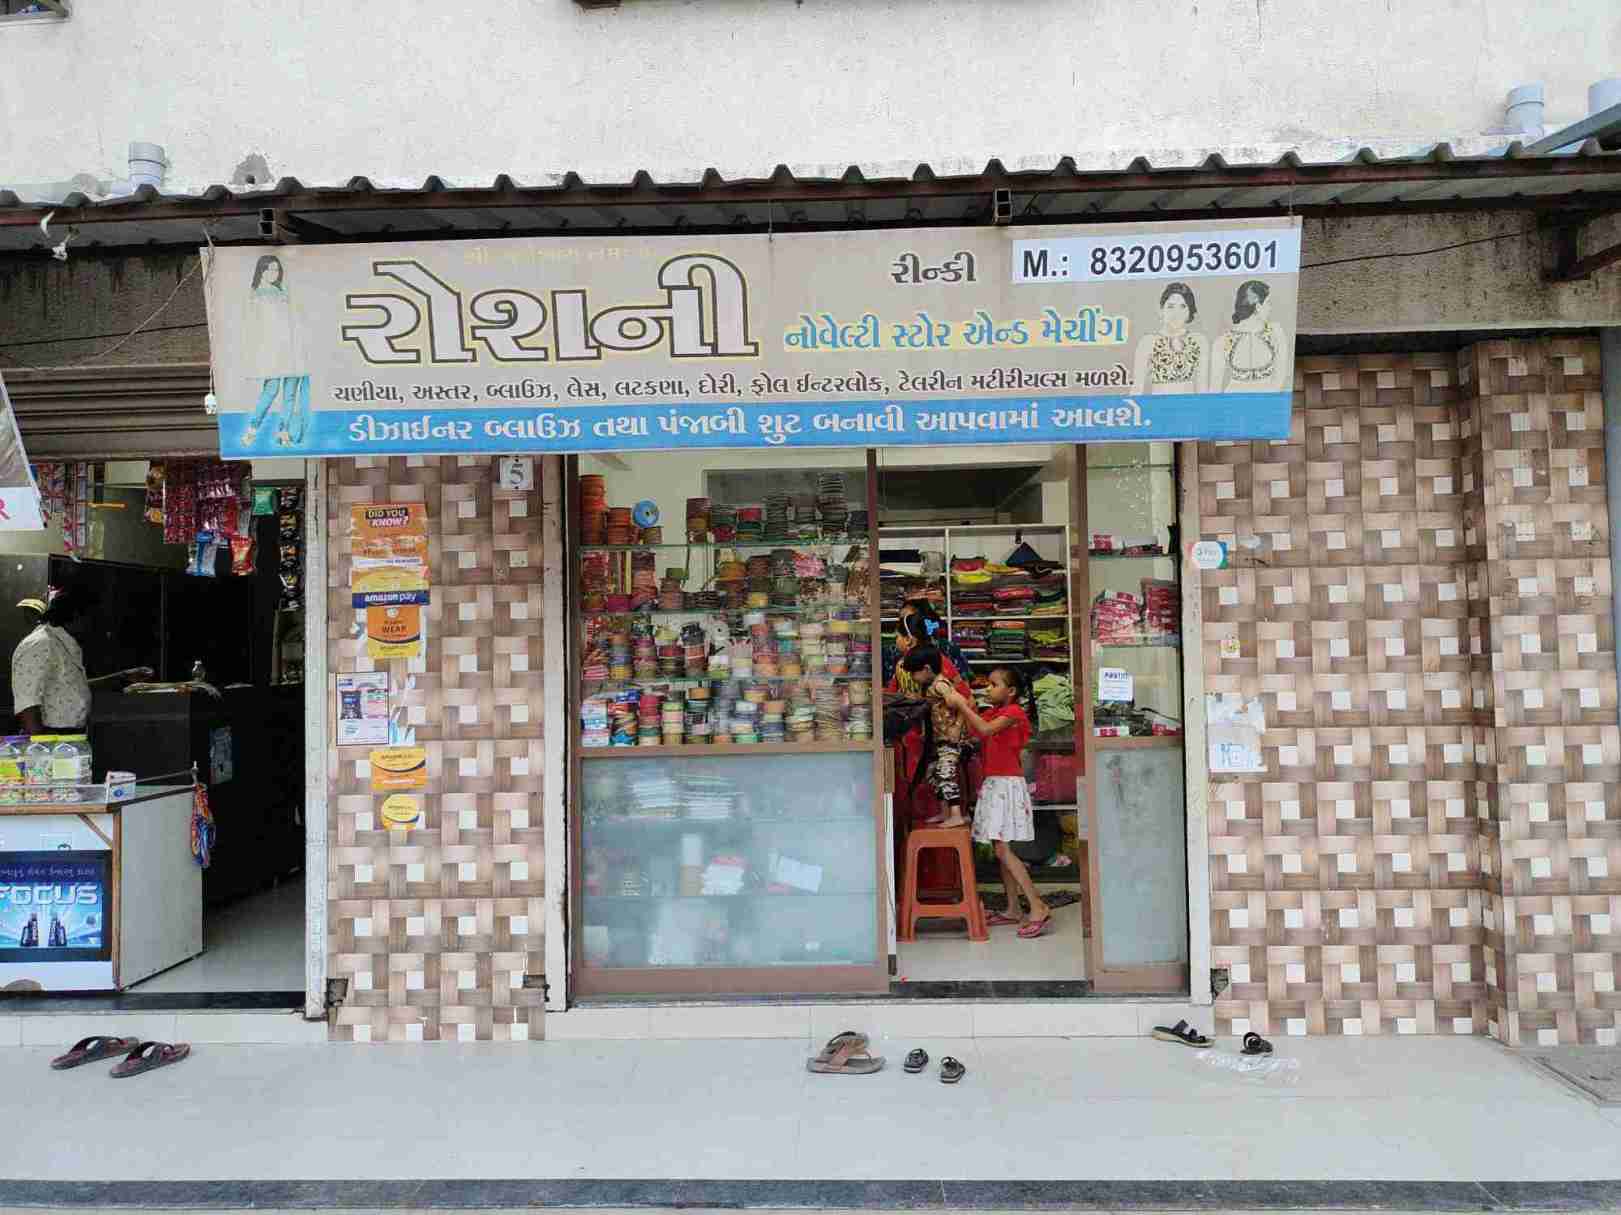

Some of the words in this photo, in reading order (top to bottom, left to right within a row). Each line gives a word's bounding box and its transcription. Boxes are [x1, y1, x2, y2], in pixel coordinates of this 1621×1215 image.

[891, 251, 976, 283] રીન્કી
[1090, 240, 1277, 275] 8320953601
[341, 254, 760, 363] રોશની
[785, 314, 881, 348] નોવેલ્ટી
[892, 312, 950, 347] સ્ટોર
[963, 310, 1029, 345] એન્ડ
[411, 384, 478, 402] અસ્તર,
[567, 377, 607, 399] લેસ,
[614, 380, 690, 398] લટકણા,
[699, 373, 742, 397] દોરી,
[750, 371, 789, 396] ફોલ
[898, 370, 962, 391] ટેલરીન
[1075, 365, 1134, 387] મળશે.
[592, 415, 648, 437] તથા
[658, 407, 748, 435] પંજાબી
[757, 413, 803, 444] શુટ
[812, 405, 905, 434] બનાવી
[915, 401, 1040, 432] આપવામાં
[1051, 398, 1152, 428] આવશે.
[511, 463, 524, 485] 5
